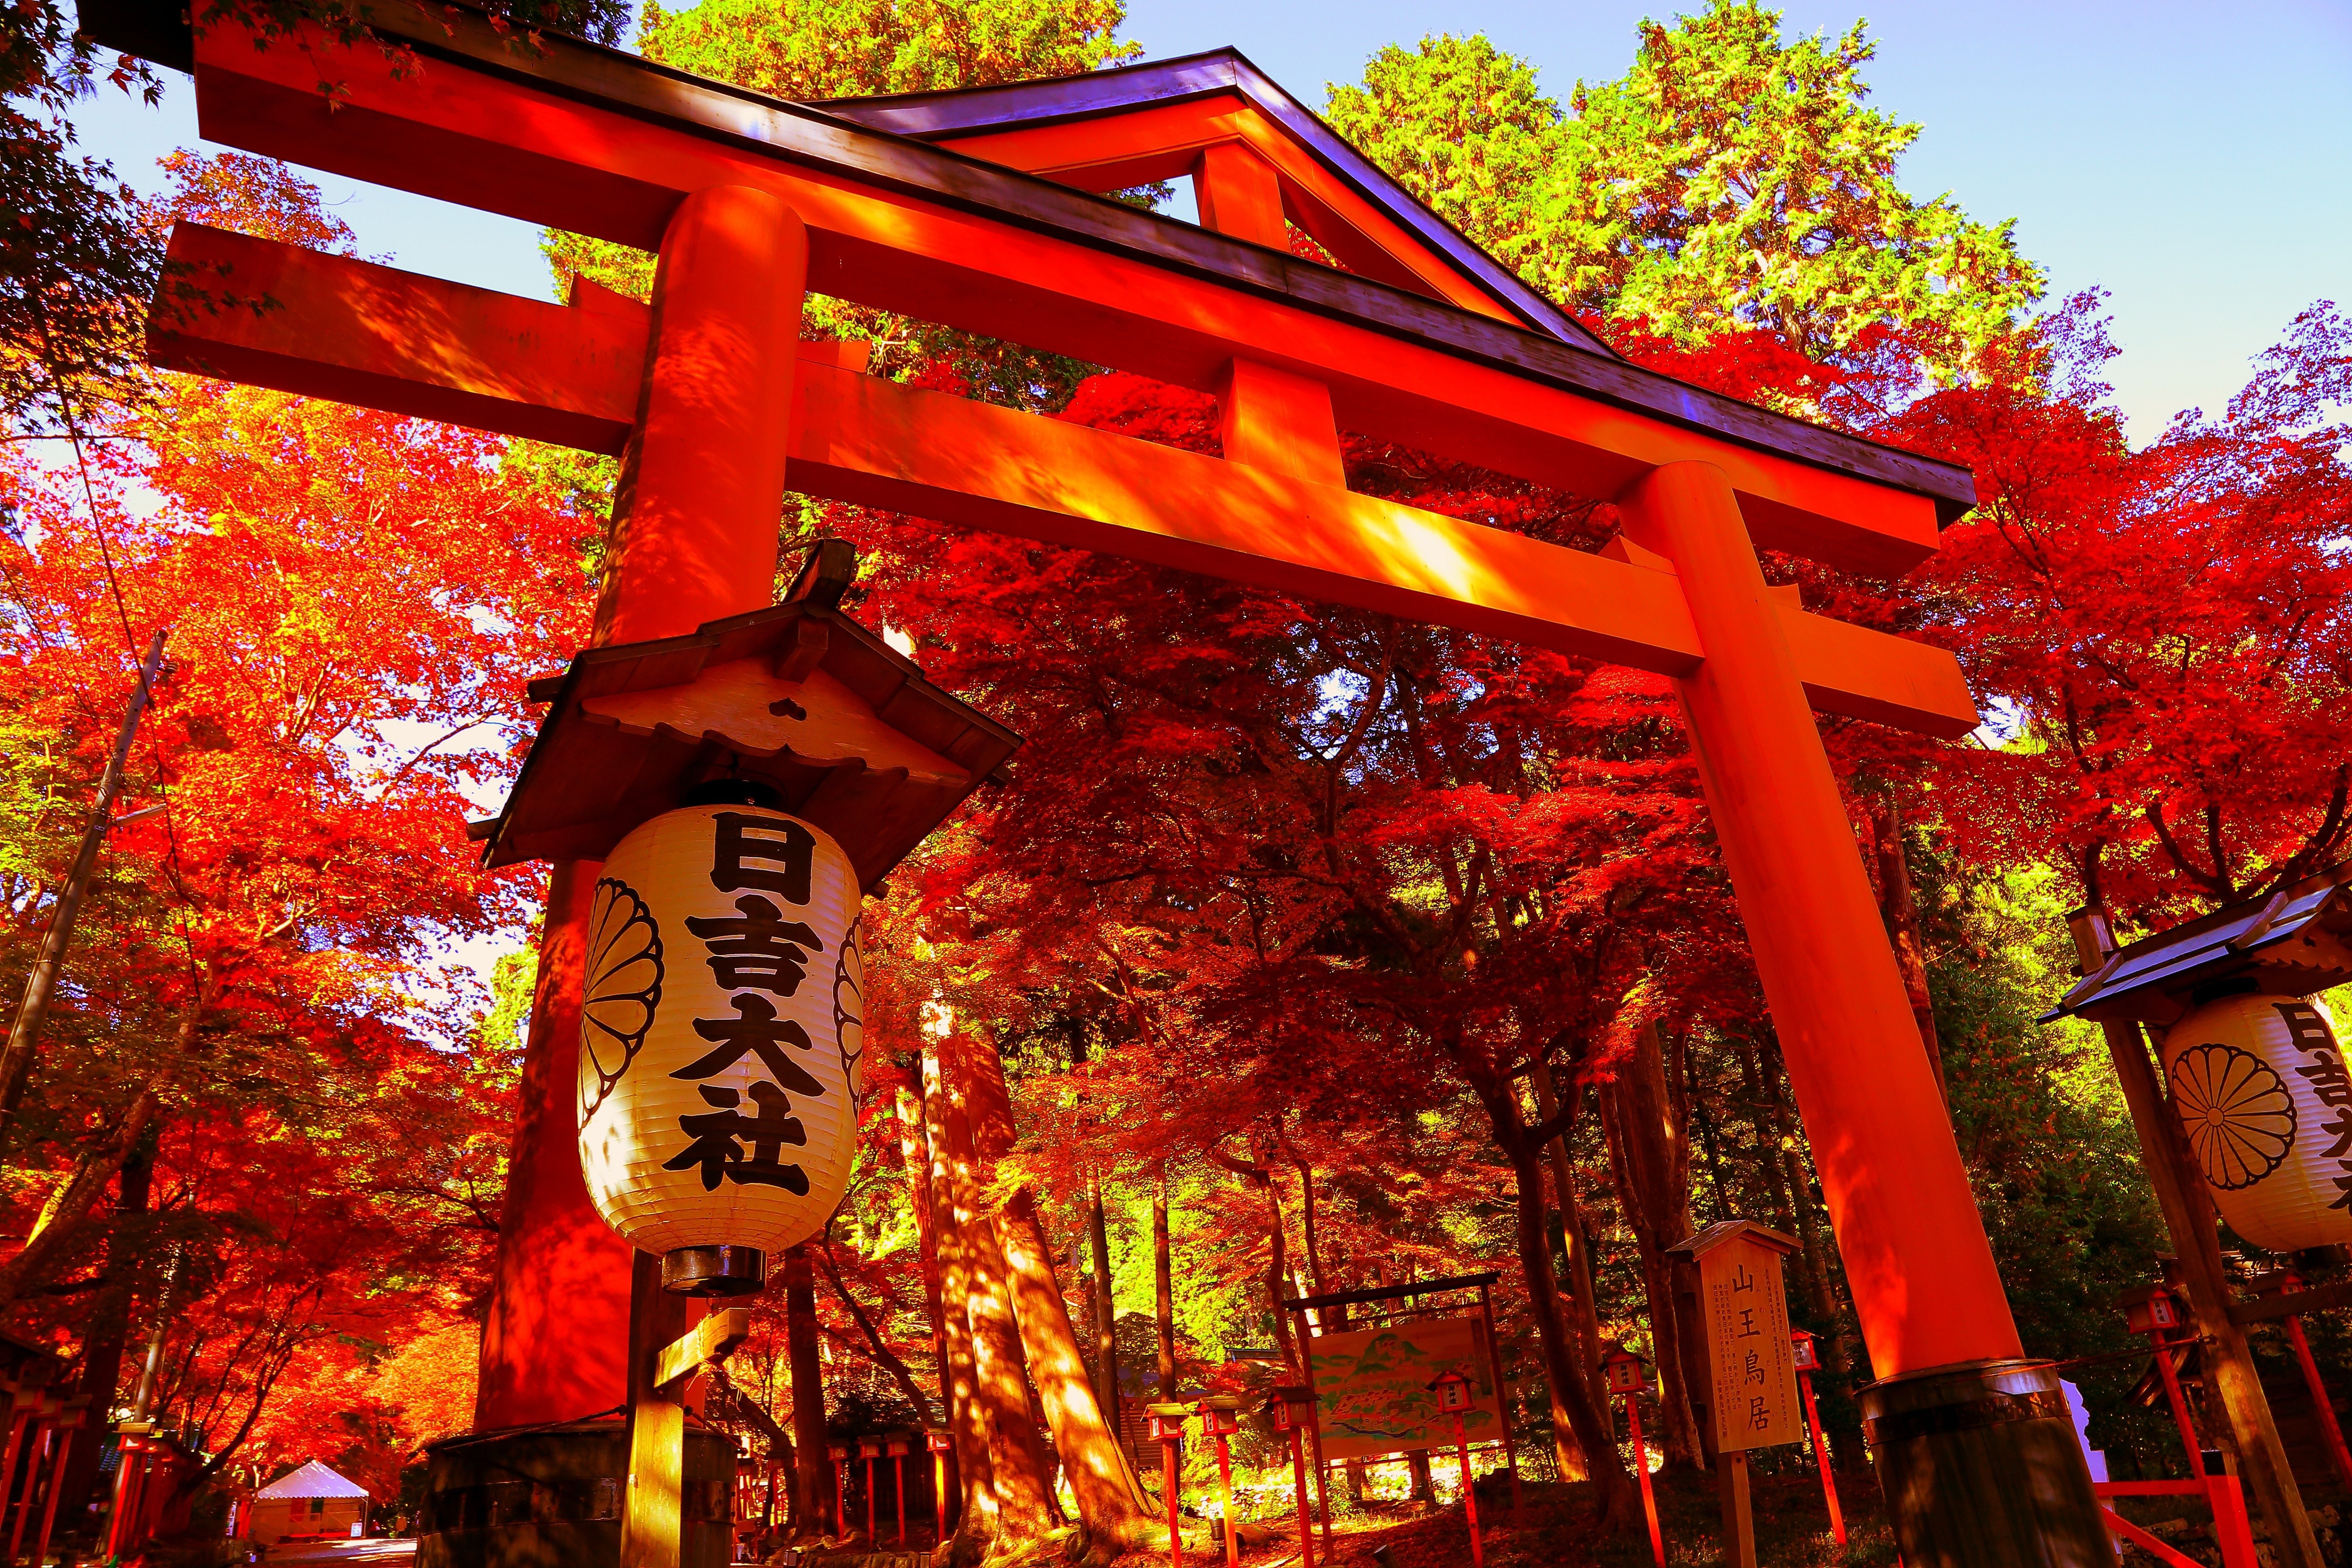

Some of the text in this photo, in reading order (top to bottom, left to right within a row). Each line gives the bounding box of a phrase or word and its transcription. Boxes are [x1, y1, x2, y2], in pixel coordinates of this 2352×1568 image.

[662, 812, 827, 1196] 日吉大社
[2271, 1002, 2352, 1215] 日吉大
[1731, 1264, 1770, 1431] 山王鳥居
